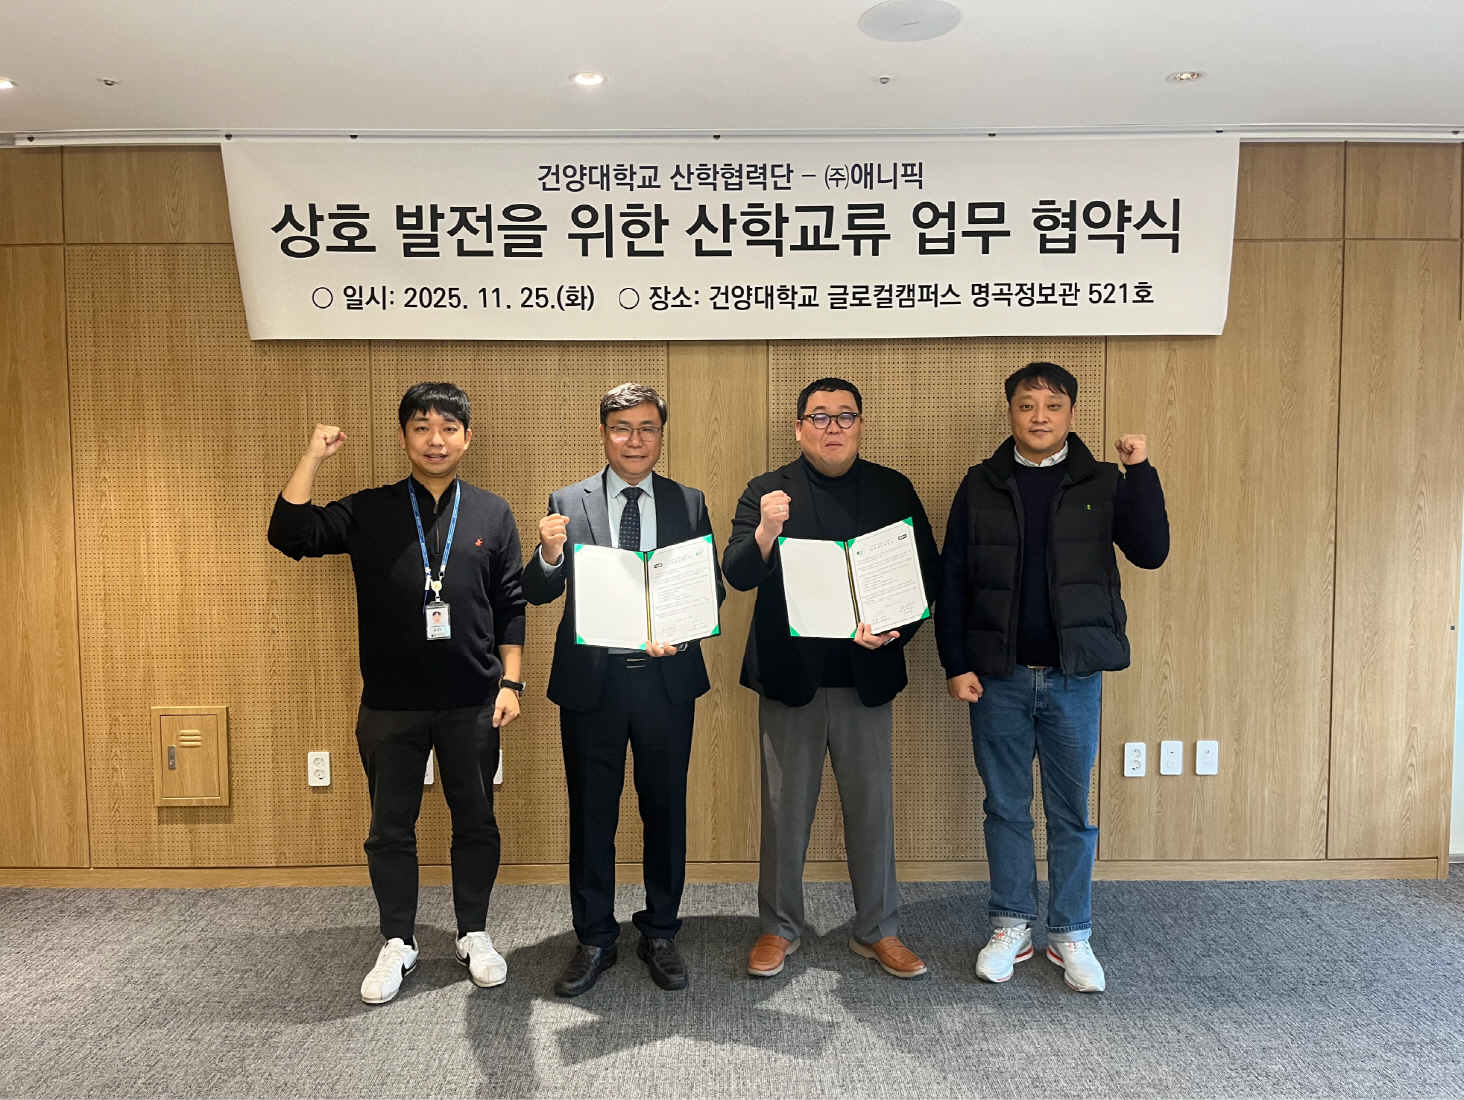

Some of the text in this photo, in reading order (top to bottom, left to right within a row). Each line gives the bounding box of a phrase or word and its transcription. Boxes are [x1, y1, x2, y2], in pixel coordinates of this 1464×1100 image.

[537, 163, 662, 193] 건양대학교
[669, 163, 794, 192] 산학협력단
[270, 198, 1181, 259] 상호 발전을 위한 산학교류 업무 협약식
[343, 284, 595, 312] 일시: 2025. 11. 25.(화)
[648, 280, 1155, 311] 장소: 건양대학교 글로컬캠퍼스 명곡정보관 521호
